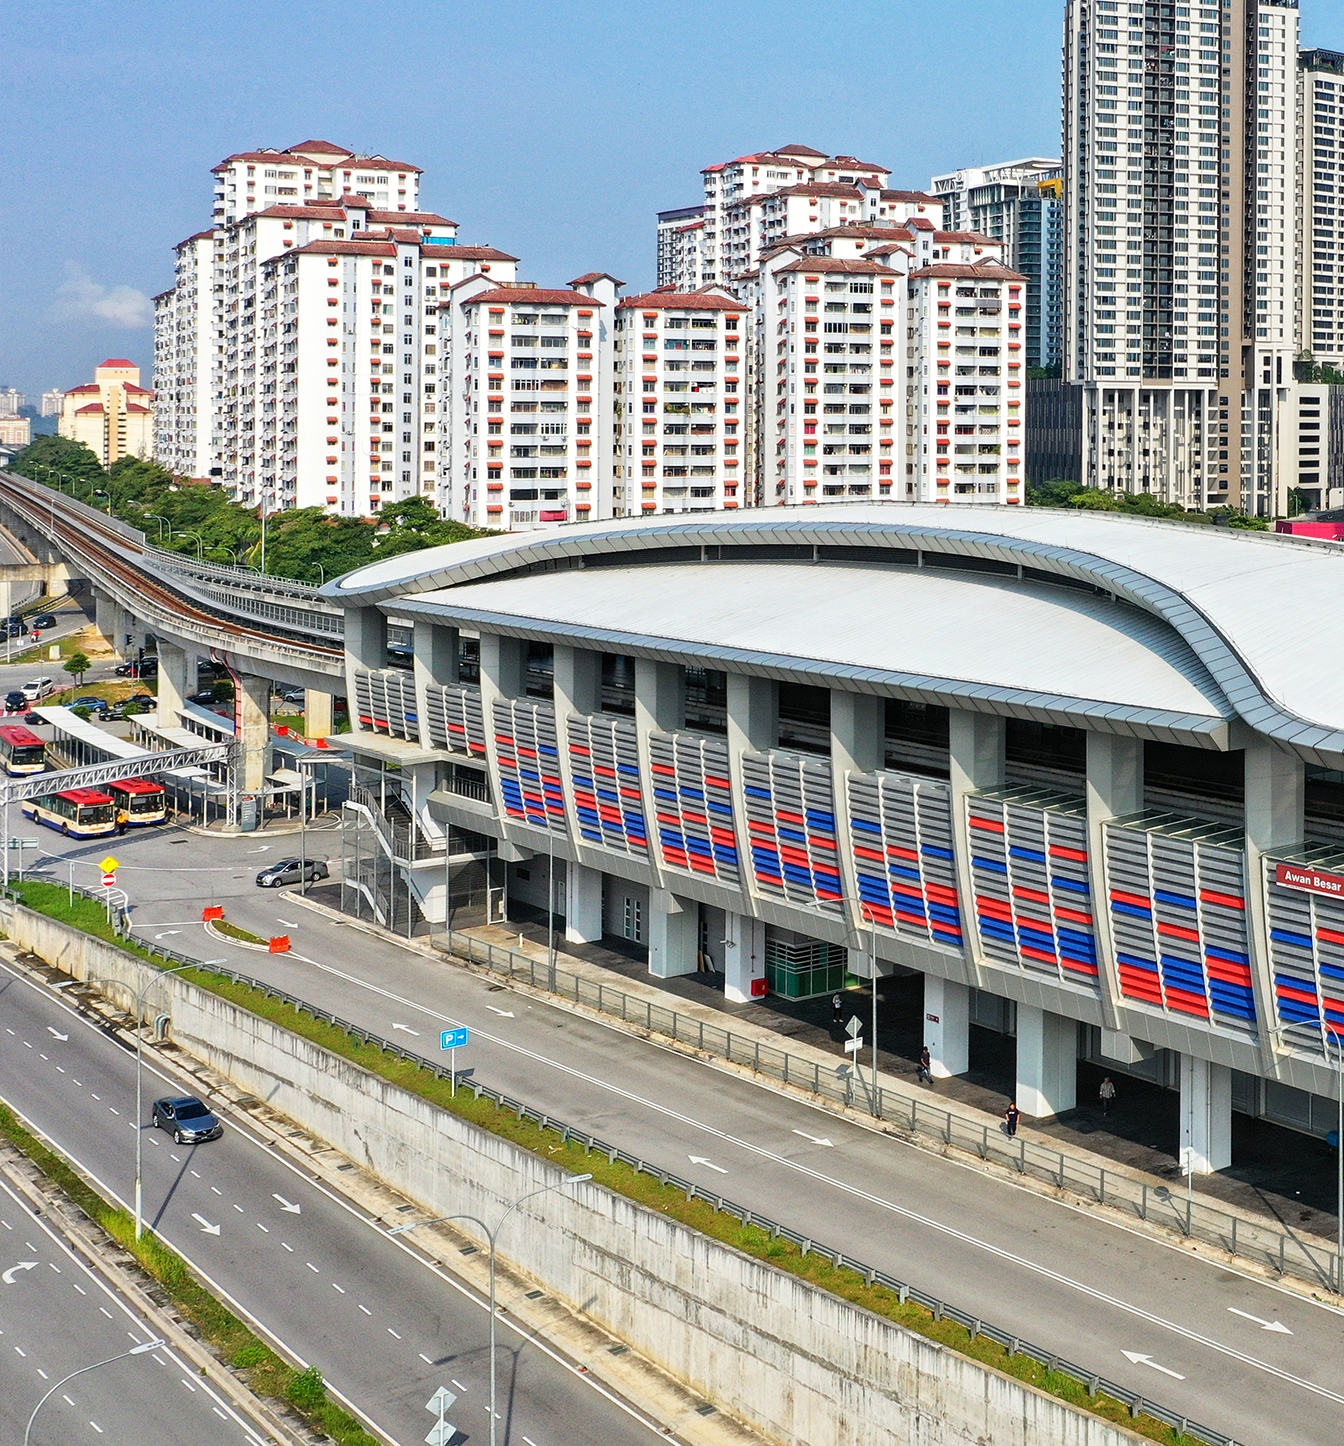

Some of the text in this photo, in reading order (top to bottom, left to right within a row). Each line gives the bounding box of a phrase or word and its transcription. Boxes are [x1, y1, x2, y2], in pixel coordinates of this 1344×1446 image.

[1285, 870, 1311, 885] Awan
[1314, 877, 1342, 891] Besar
[446, 1035, 454, 1045] P
